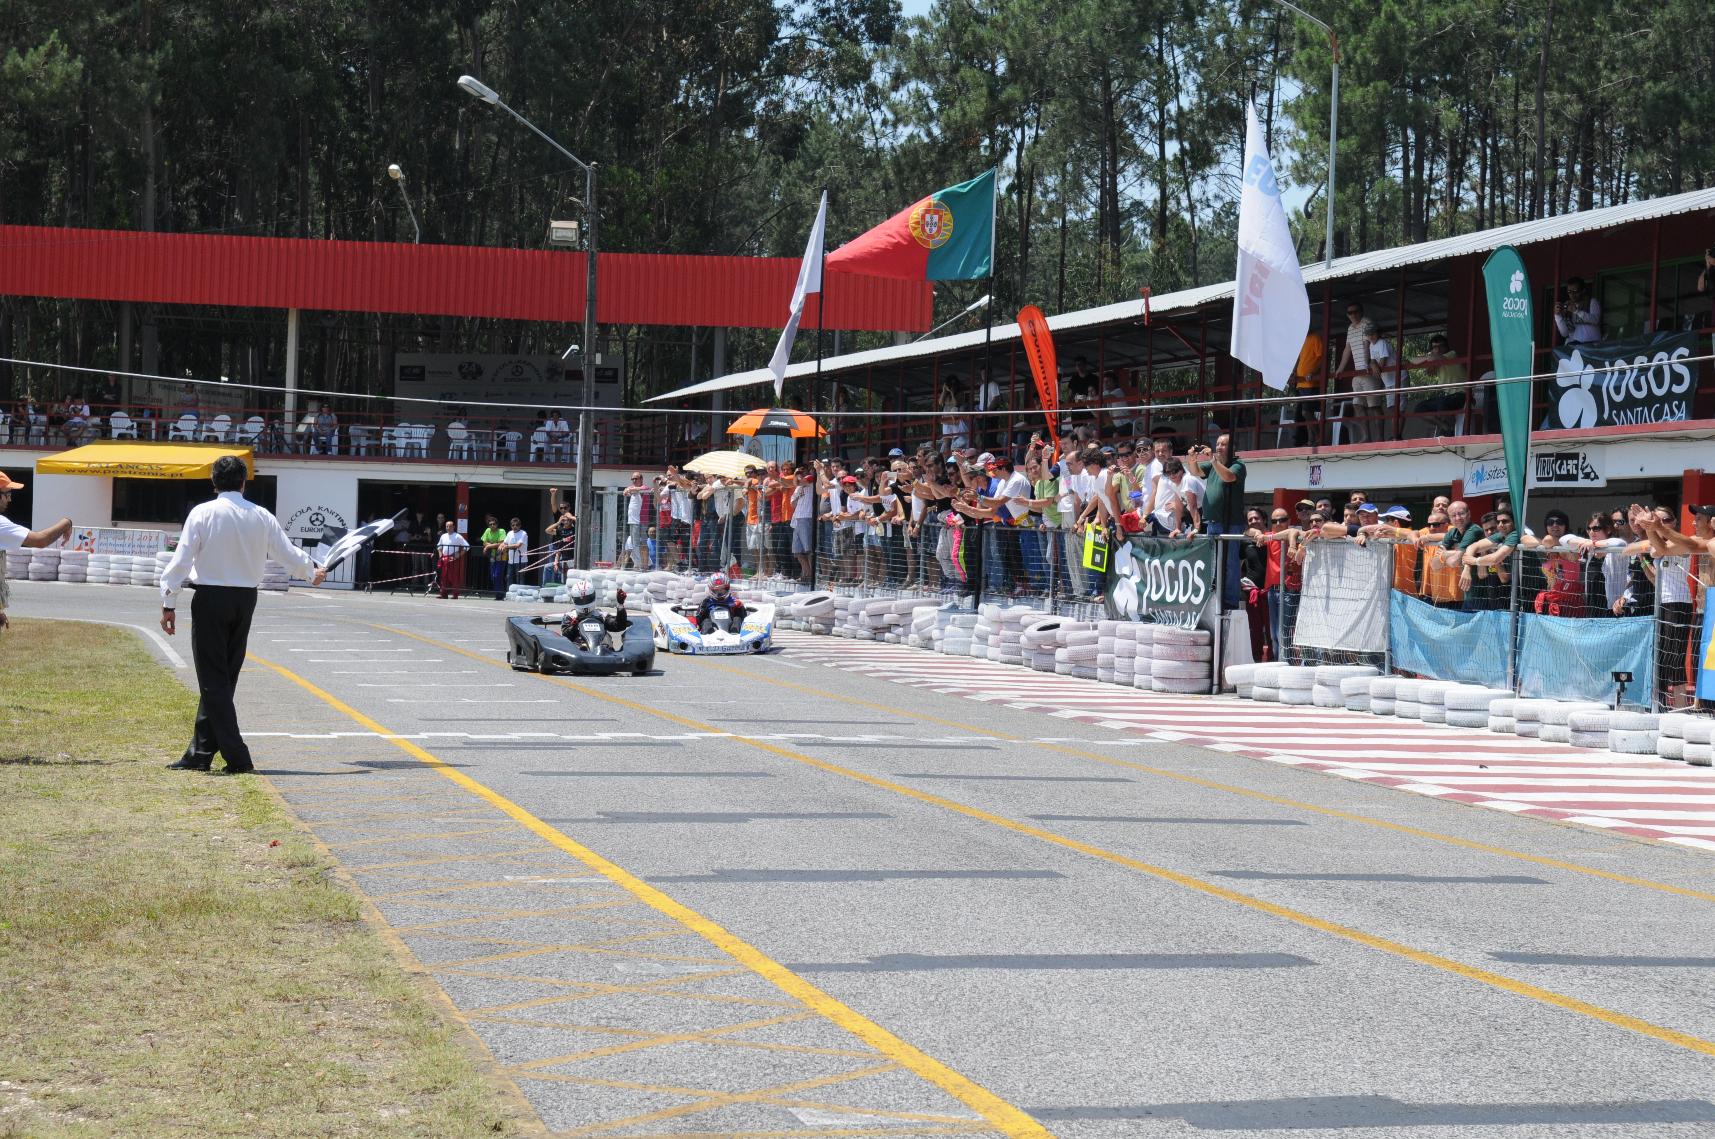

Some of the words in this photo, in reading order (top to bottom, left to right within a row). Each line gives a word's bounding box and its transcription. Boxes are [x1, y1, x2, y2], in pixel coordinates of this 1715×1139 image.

[1602, 346, 1691, 420] JOGOS
[285, 506, 312, 531] ESCOLA
[318, 505, 348, 530] KARTIN
[1142, 558, 1206, 615] JOGOS
